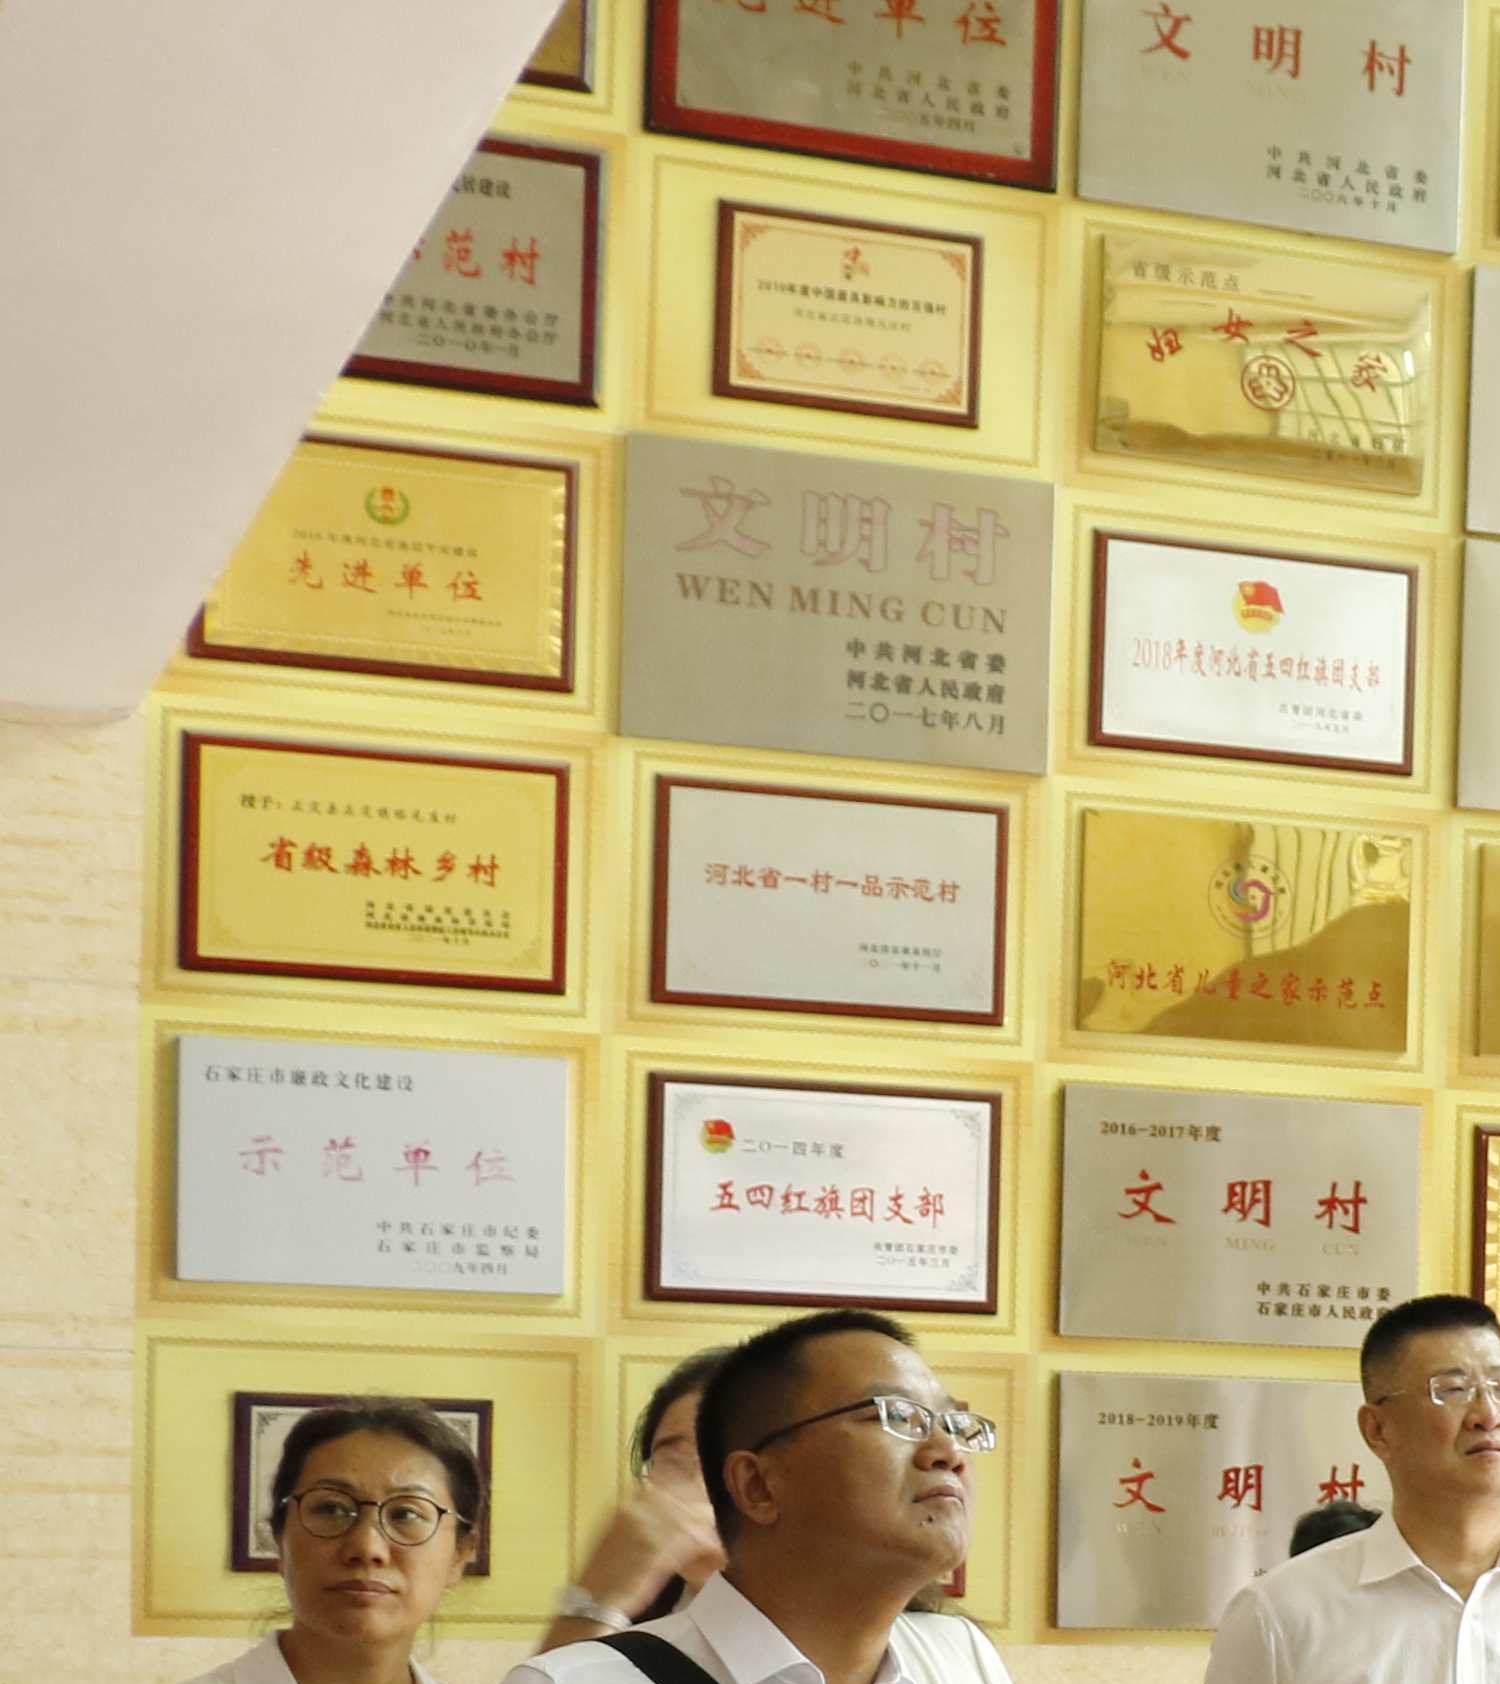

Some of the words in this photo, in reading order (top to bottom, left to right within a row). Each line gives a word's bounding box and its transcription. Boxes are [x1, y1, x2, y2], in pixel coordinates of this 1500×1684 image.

[1140, 3, 1413, 98] 文明村
[846, 81, 1011, 121] 河北省人民政府
[848, 60, 1011, 102] 中共河北省委
[1265, 163, 1427, 203] 河北省人民政府
[1266, 144, 1428, 186] 中共河北省委
[453, 174, 512, 199] 居建设
[413, 228, 542, 286] 范村
[1132, 259, 1241, 293] 省级示范点
[1147, 308, 1389, 392] 妇女之家
[675, 475, 1010, 587] 文明村
[289, 550, 483, 602] 先进单位
[676, 571, 774, 610] WEN
[790, 584, 905, 624] MING
[921, 600, 1008, 633] CUN
[846, 636, 1007, 676] 中共河北省委
[846, 668, 1006, 705] 河北省人民政府
[845, 699, 1005, 736] 二〇一七年八月
[260, 835, 501, 889] 省级森林乡村
[704, 862, 961, 904] 河北省一村一品示范村
[1107, 959, 1387, 1009] 河北省儿童之家示范点
[203, 1063, 415, 1093] 石家庄市廉政文化建设
[238, 1134, 515, 1187] 示范单位
[709, 1180, 946, 1229] 五四红旗团支部
[1117, 1168, 1368, 1234] 文明村
[376, 1219, 540, 1241] 中共石家庄市纪委
[1256, 1280, 1392, 1303] 中共石家庄市委
[1112, 1456, 1365, 1513] 文明村
